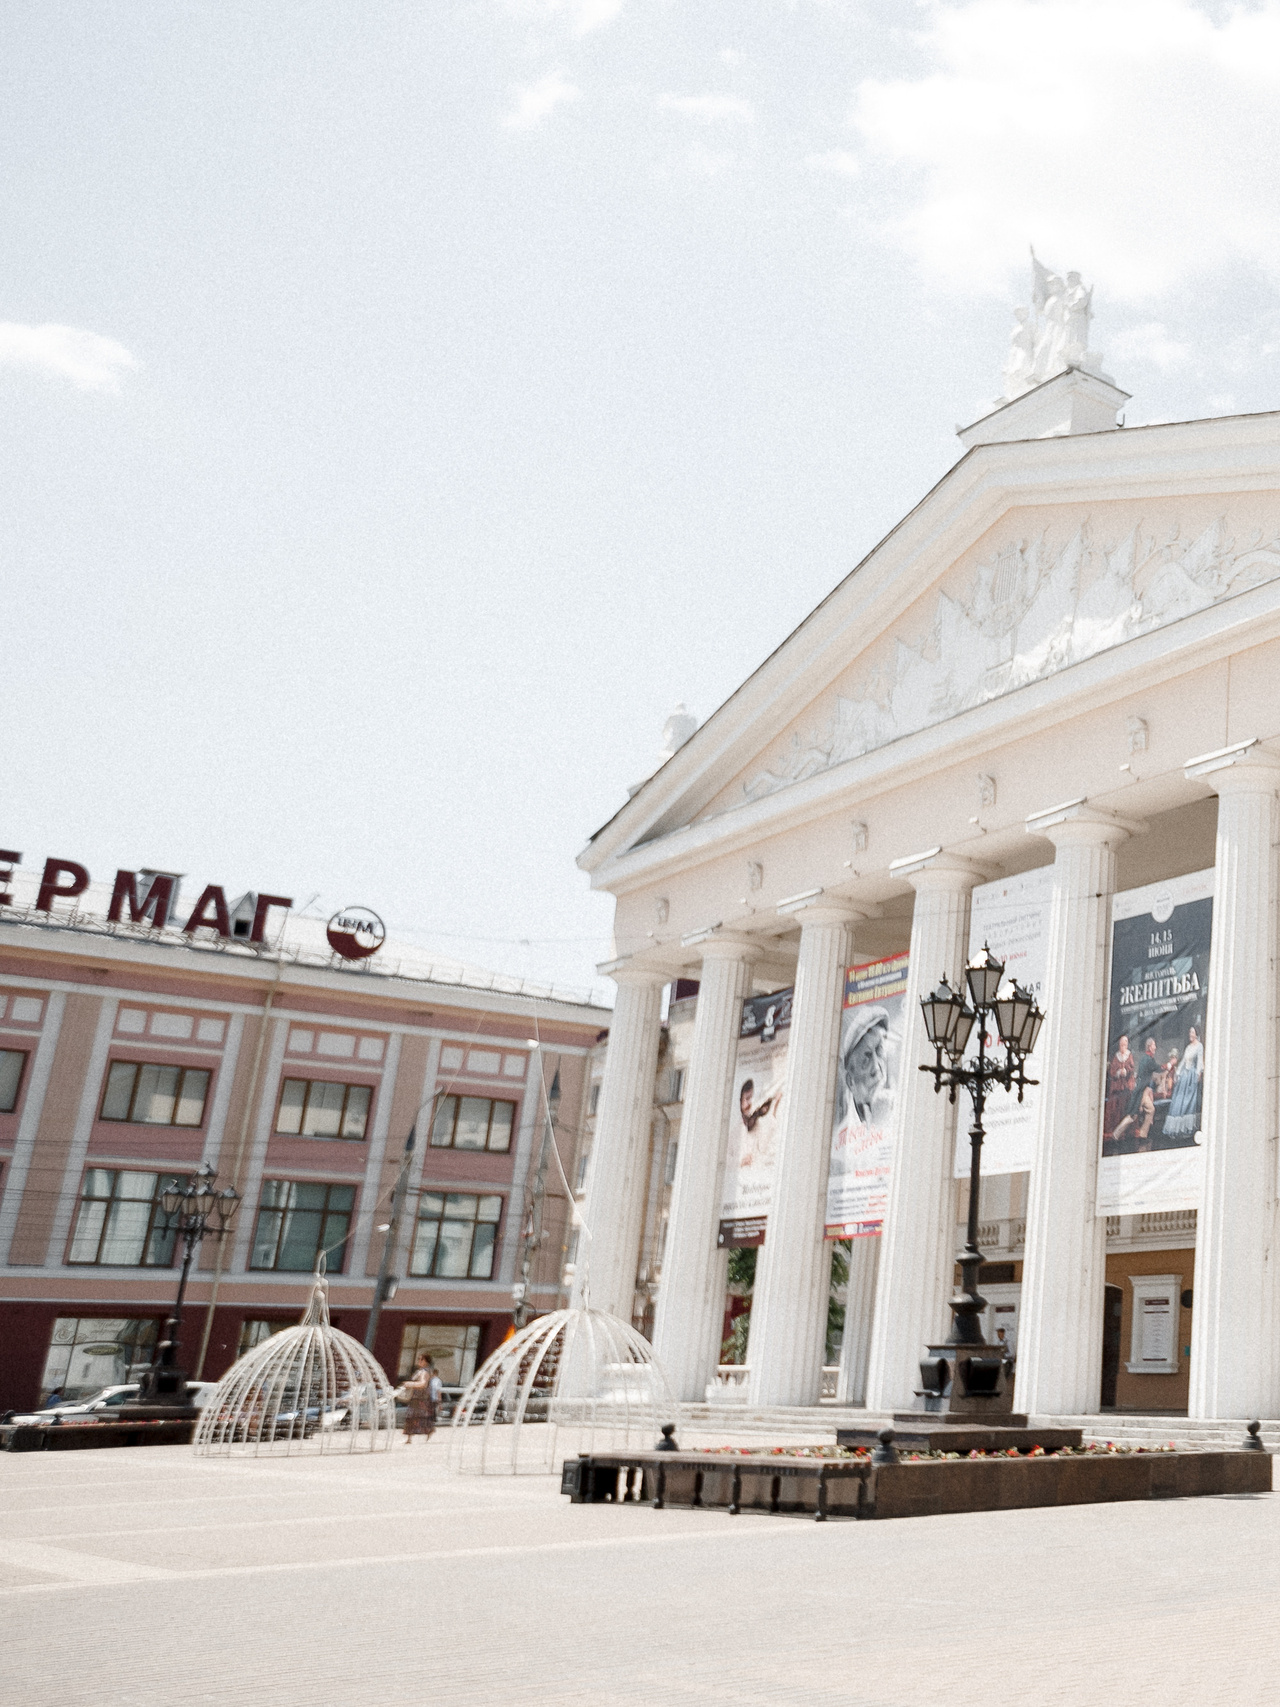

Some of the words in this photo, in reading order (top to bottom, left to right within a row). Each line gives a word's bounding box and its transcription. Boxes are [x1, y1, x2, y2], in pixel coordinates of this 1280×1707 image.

[1163, 929, 1173, 942] 15
[1148, 943, 1173, 958] ИЮНЯ
[1120, 971, 1200, 1006] ЖЕНИТЬБА
